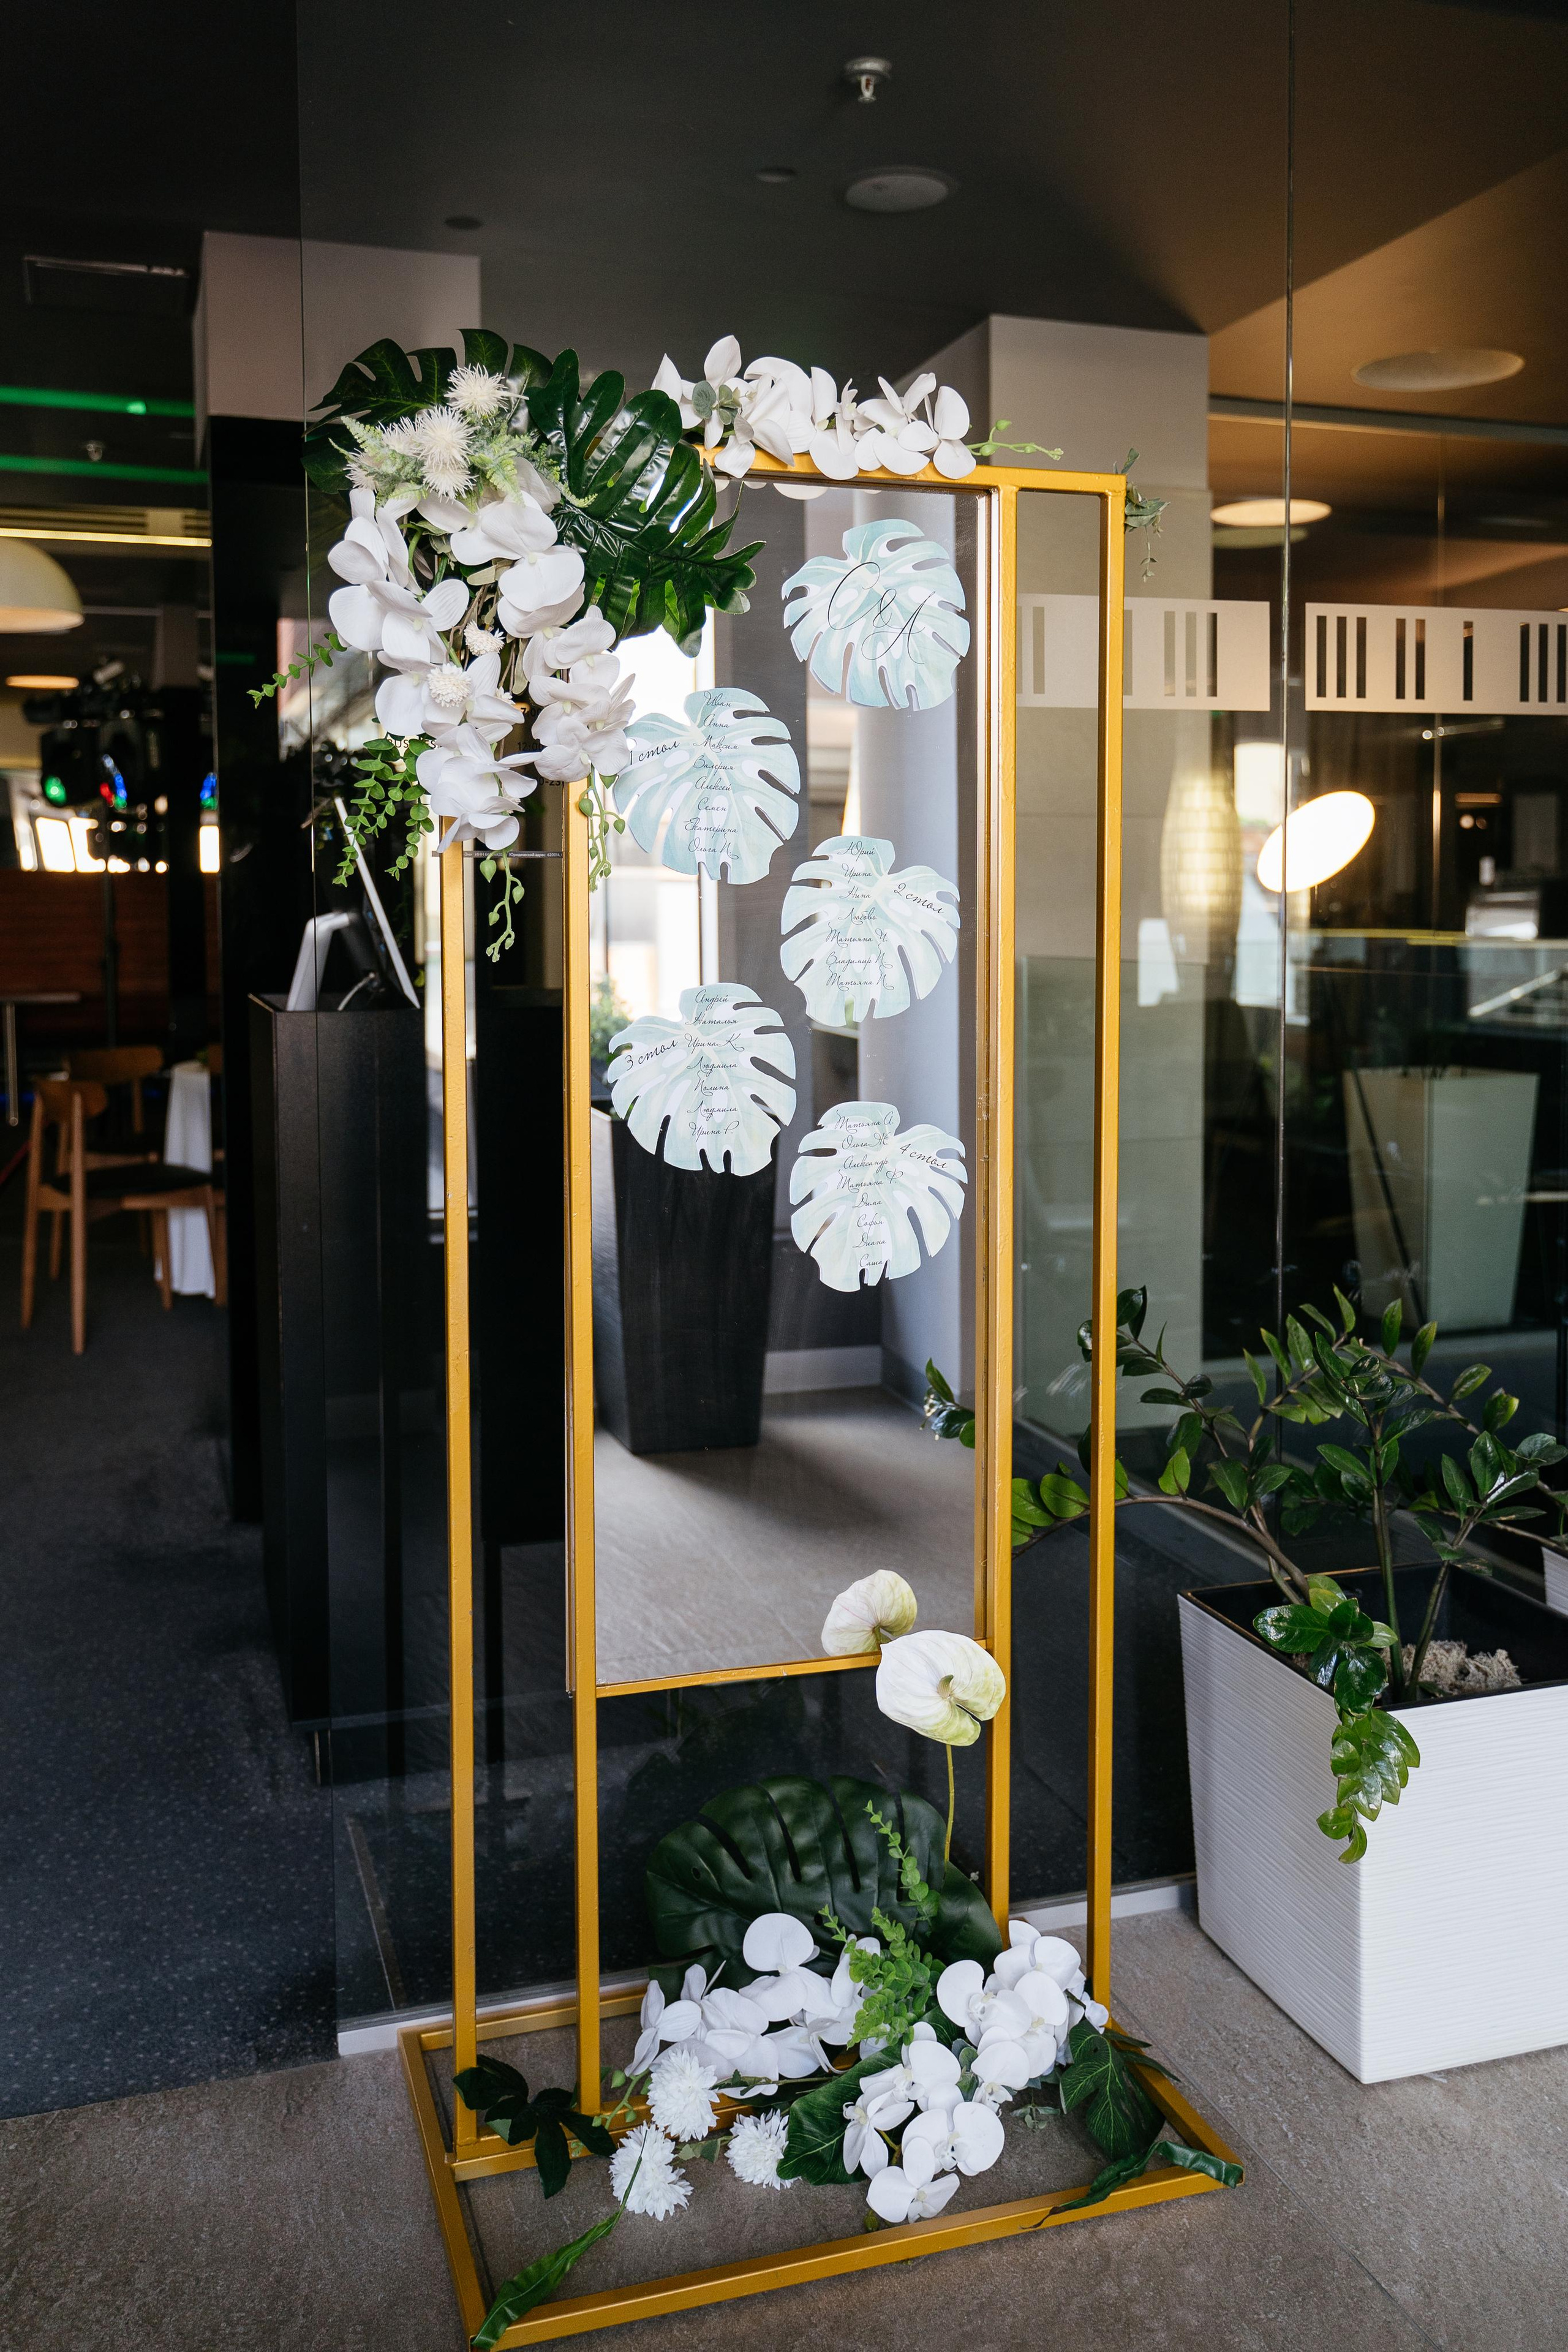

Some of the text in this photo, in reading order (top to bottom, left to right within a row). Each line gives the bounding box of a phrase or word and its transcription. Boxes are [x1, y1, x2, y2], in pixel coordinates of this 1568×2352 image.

[703, 691, 732, 707] Иван
[703, 714, 729, 728] Анна
[629, 741, 680, 766] 1 стол
[693, 734, 740, 753] Максим
[693, 755, 736, 776] Валерия
[695, 777, 732, 791] Алексей
[697, 797, 728, 812] Семен
[683, 817, 738, 839] Екатерина
[688, 837, 718, 853] Ольга
[837, 840, 876, 861] Юрий
[841, 863, 873, 884] Ирина
[839, 886, 872, 899] Нина
[894, 883, 944, 914] 2 стол
[838, 907, 878, 925] Любовь
[825, 921, 873, 948] Татьяна
[826, 951, 872, 973] Владимир
[826, 965, 874, 992] Татьяна
[695, 989, 729, 1011] Андрей
[685, 1012, 739, 1025] Наталья
[684, 1033, 717, 1054] Ирина
[625, 1040, 678, 1071] 3 стол
[686, 1056, 739, 1077] Людмила
[694, 1069, 731, 1097] Полина
[686, 1100, 739, 1121] Людмила
[688, 1120, 722, 1142] Ирина
[834, 1110, 881, 1134] Татьяна
[842, 1134, 870, 1150] Ольга
[843, 1154, 889, 1174] Александр
[900, 1144, 949, 1169] 4 стол
[836, 1169, 884, 1194] Татьяна
[852, 1193, 882, 1208] Дима
[852, 1232, 887, 1248] Диана
[859, 1254, 884, 1268] Саша
